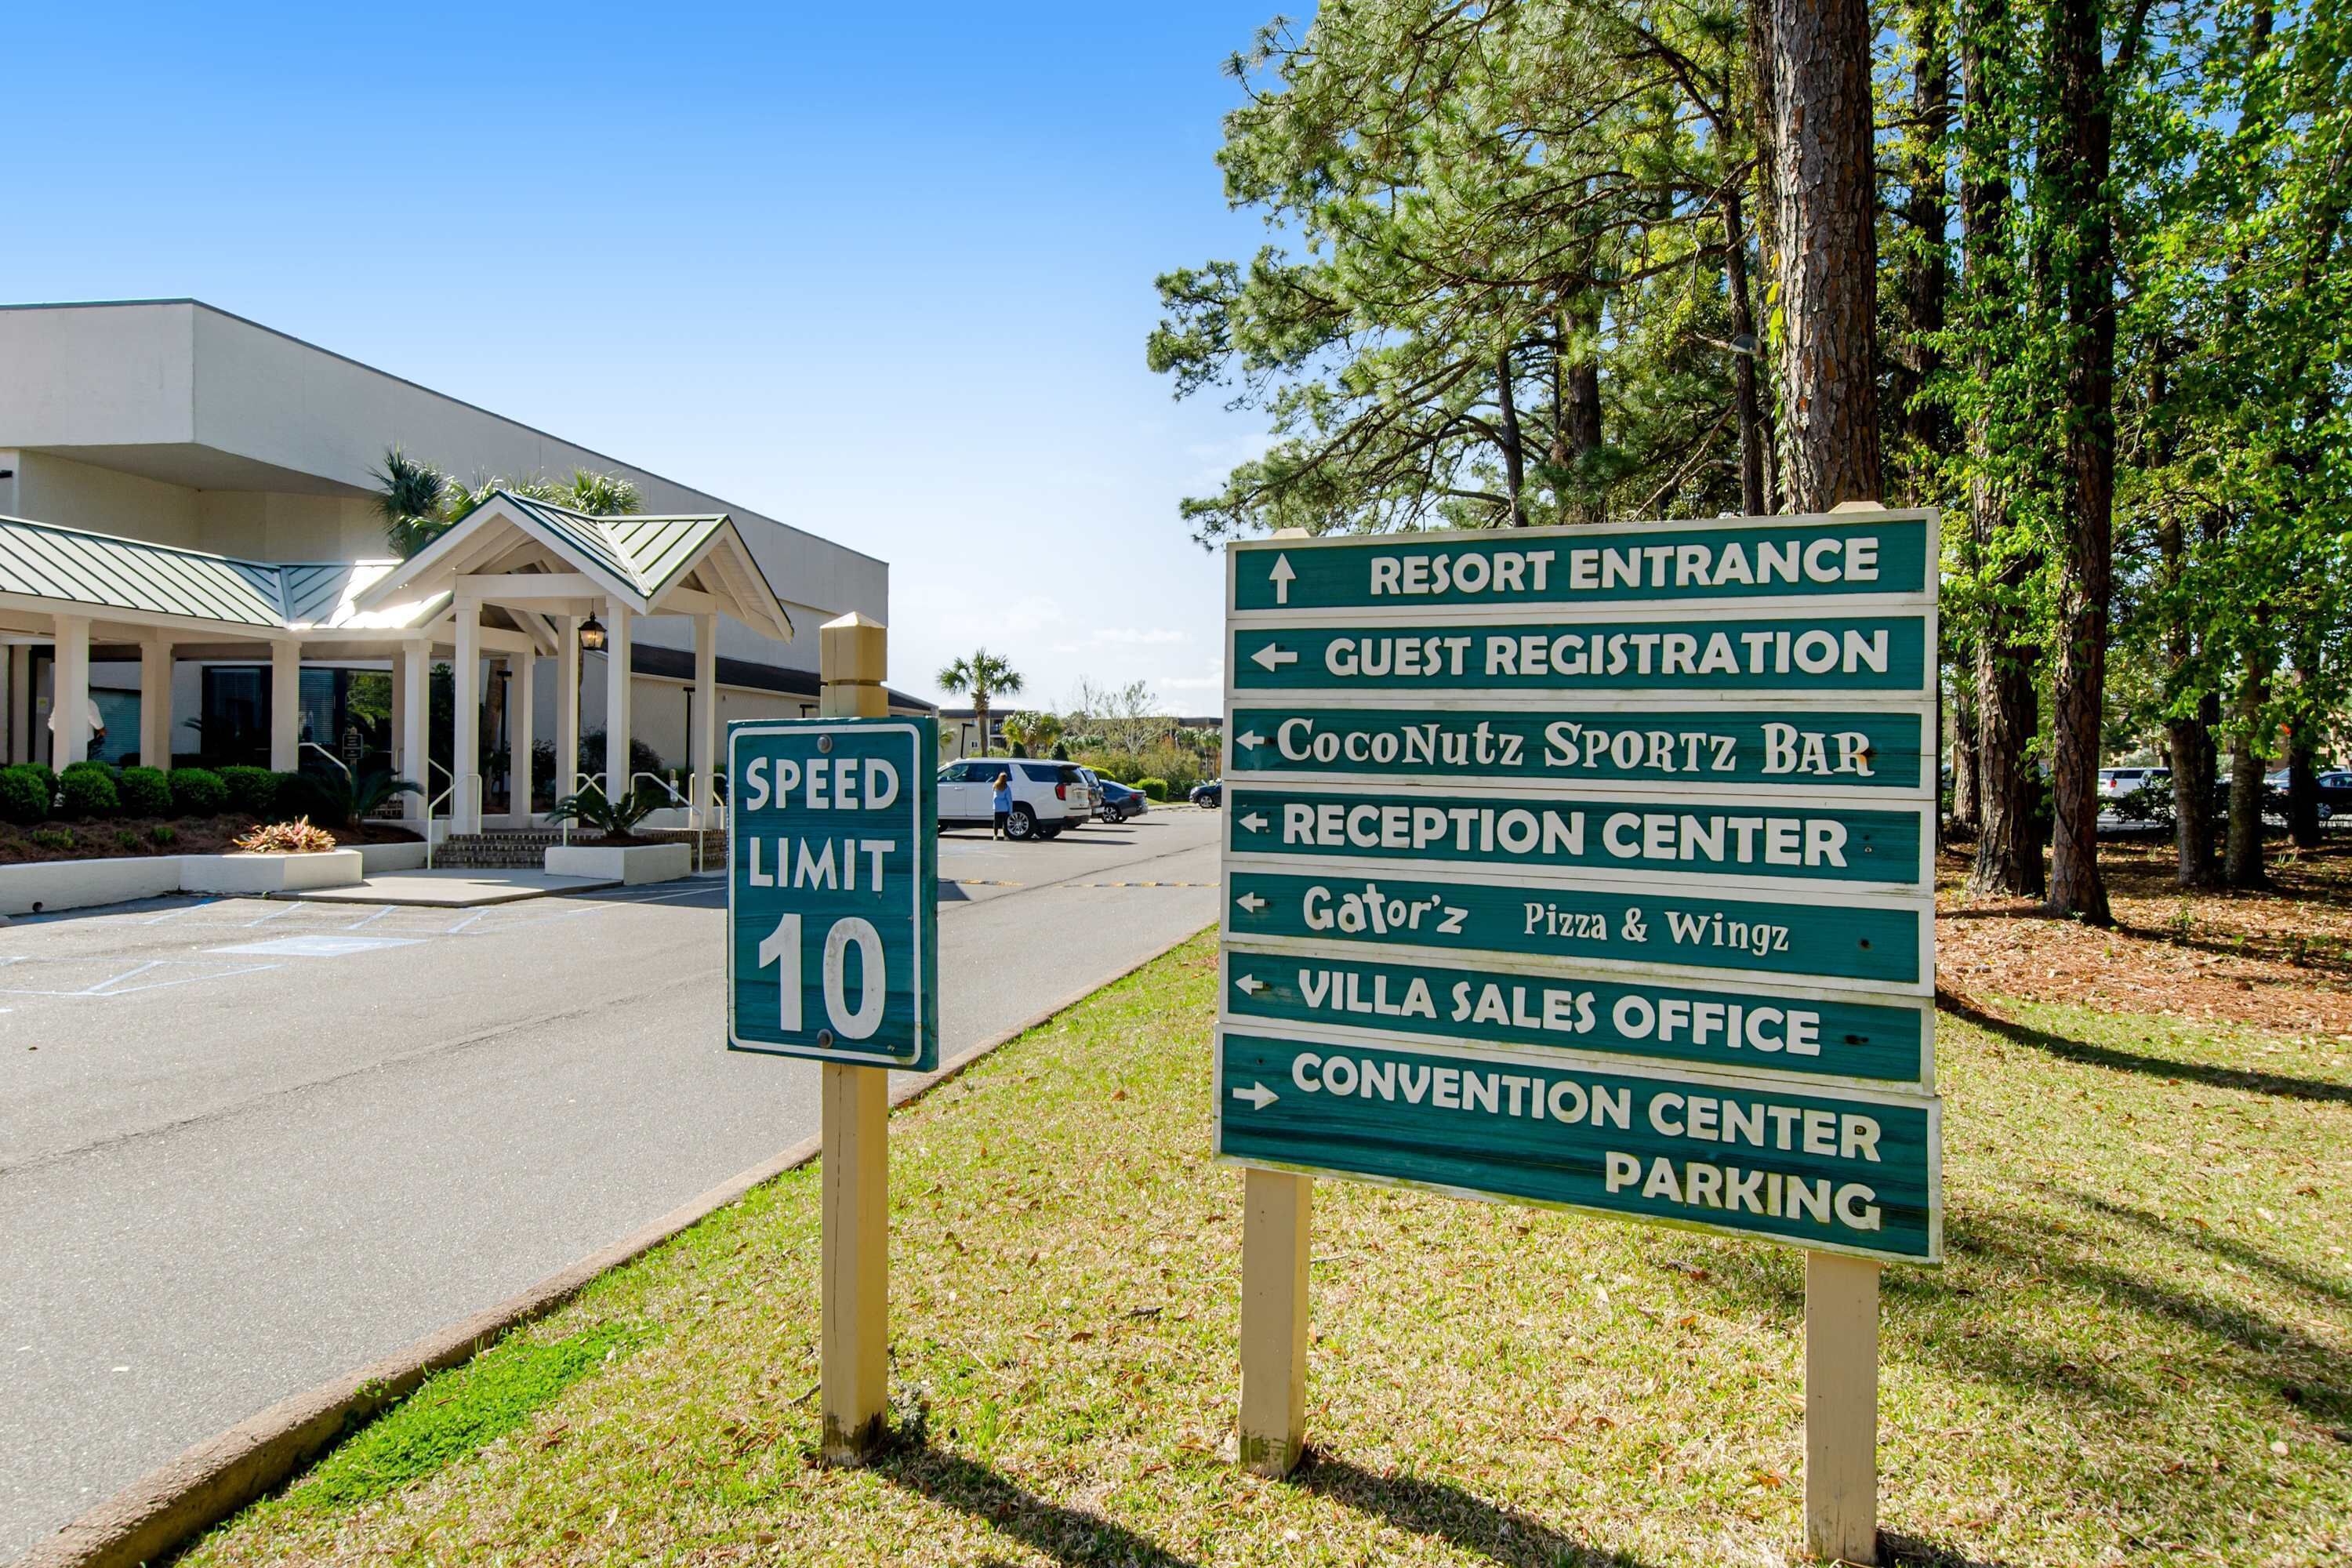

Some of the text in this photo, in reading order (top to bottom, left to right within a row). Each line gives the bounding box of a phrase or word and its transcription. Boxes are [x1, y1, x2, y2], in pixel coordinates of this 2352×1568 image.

[1371, 537, 1878, 594] RESORT ENTRANCE
[1326, 629, 1888, 675] GUEST REGISTRATION
[1761, 723, 1875, 776] BAR
[747, 757, 898, 810] SPEED
[750, 837, 895, 891] LIMIT
[1283, 804, 1849, 868] RECEPTION CENTER
[1524, 903, 1606, 940] Pizza
[1622, 908, 1646, 942] &
[1664, 912, 1788, 956] Wingz
[759, 914, 885, 1040] 10
[1298, 969, 1821, 1056] VILLA SALES OFFICE
[1293, 1052, 1881, 1162] CONVENTION CENTER
[1606, 1151, 1880, 1231] PARKING
